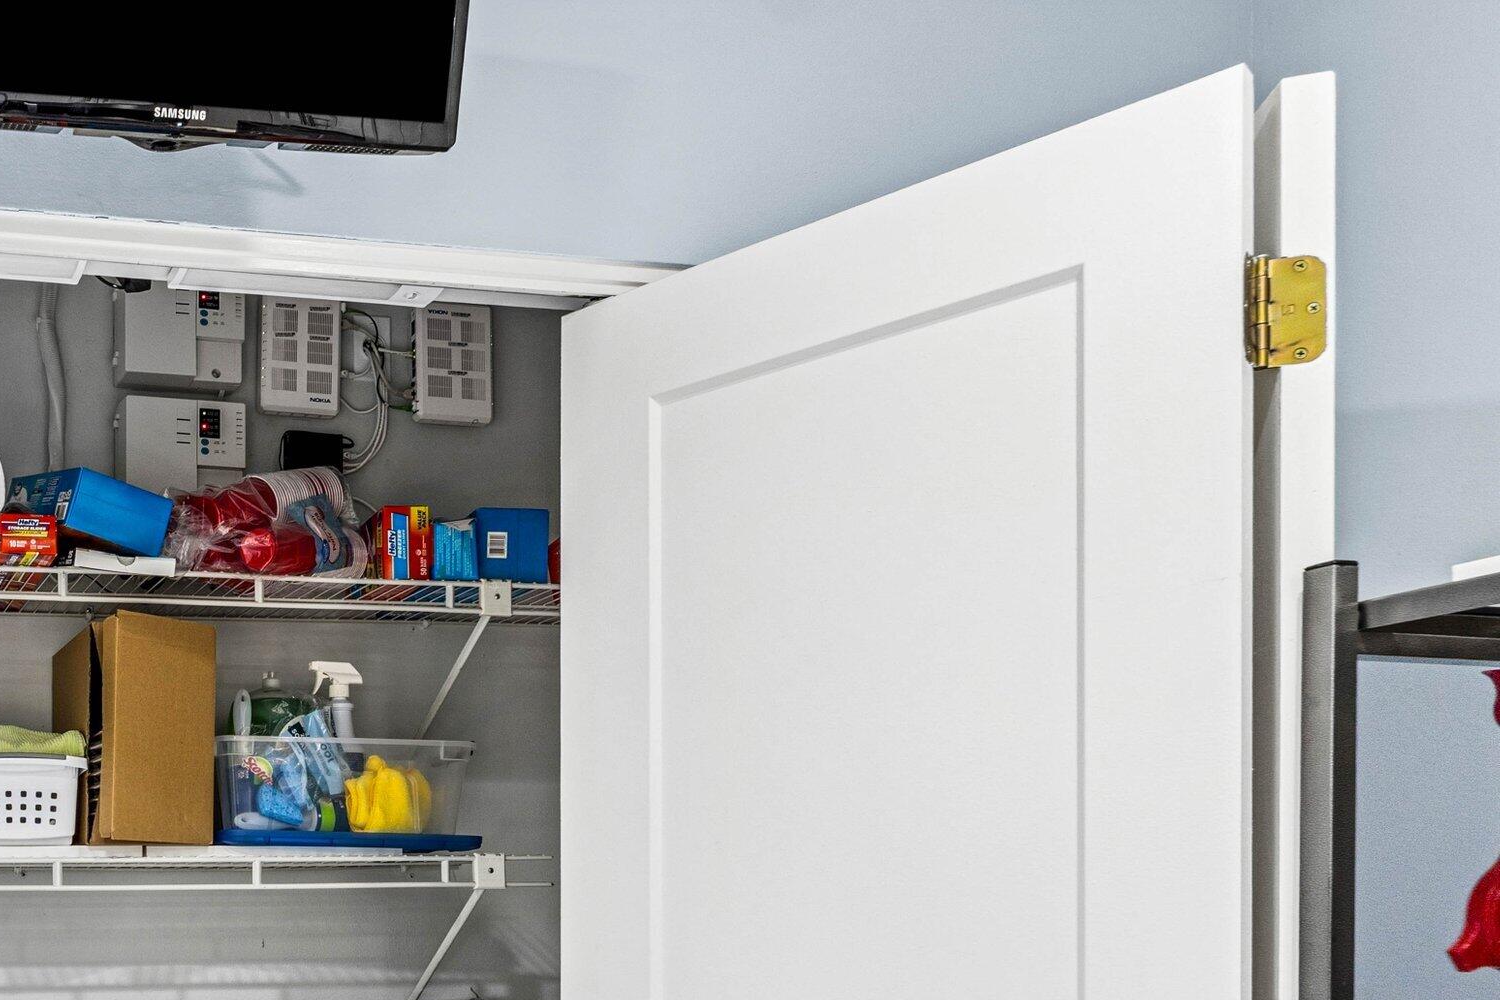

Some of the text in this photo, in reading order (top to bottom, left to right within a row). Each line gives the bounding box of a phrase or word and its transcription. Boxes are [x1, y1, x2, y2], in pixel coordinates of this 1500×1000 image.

[153, 106, 207, 121] SAMSUNG
[388, 530, 396, 556] Hefty
[420, 567, 427, 576] 50
